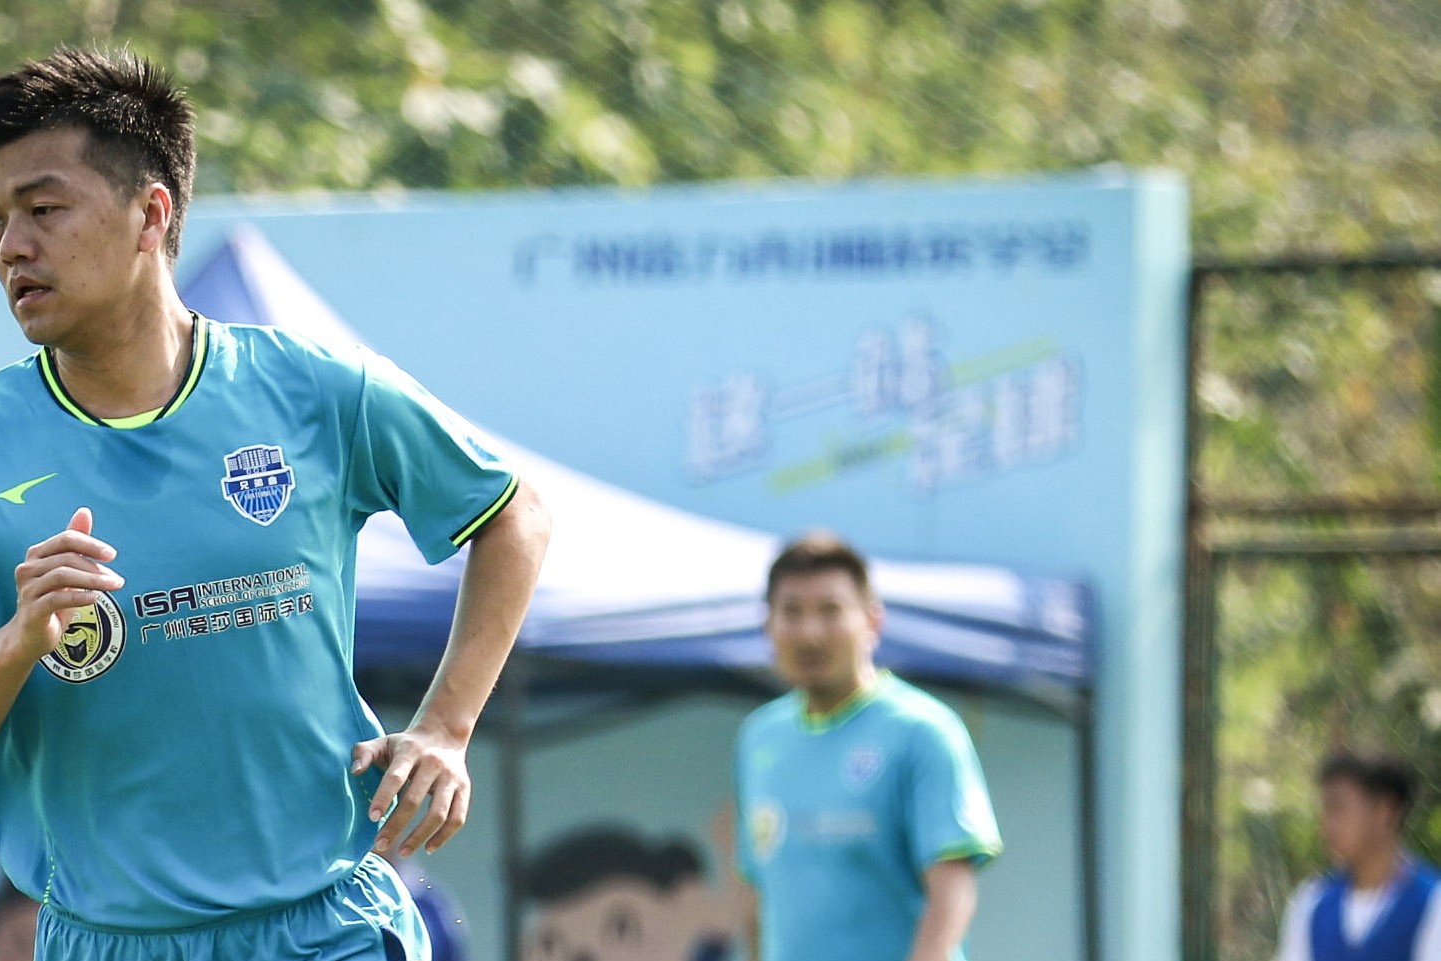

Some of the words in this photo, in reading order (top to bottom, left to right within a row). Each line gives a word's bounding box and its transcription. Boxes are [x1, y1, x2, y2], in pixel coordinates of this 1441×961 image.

[198, 562, 308, 597] INTERNATIONAL
[200, 593, 242, 608] SCHOOL
[242, 590, 255, 602] OF
[256, 576, 311, 598] GUANGZHOU
[97, 595, 121, 630] UANGZHOU
[134, 586, 197, 617] ISA
[141, 593, 314, 645] 广州爱莎国际学校
